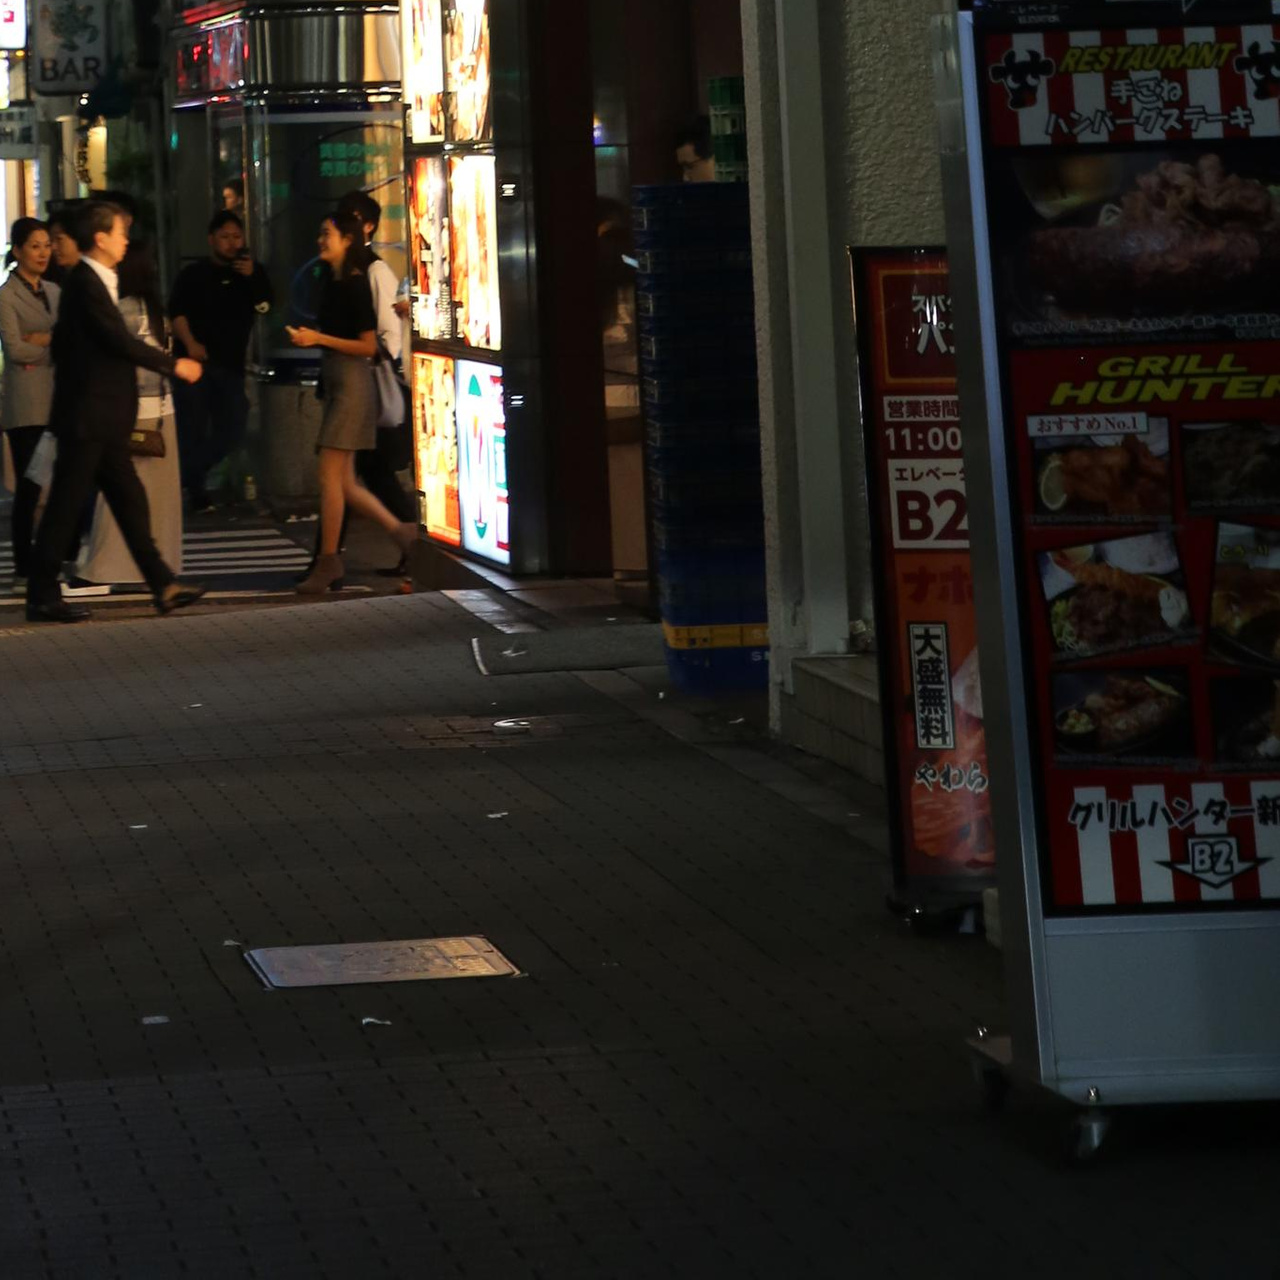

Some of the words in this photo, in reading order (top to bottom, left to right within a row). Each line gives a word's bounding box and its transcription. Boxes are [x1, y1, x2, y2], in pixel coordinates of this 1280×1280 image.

[39, 55, 101, 83] BAR
[1058, 42, 1238, 74] RESTAURANT
[1046, 105, 1255, 136] ハンバーグステーキ
[912, 294, 952, 313] スパ
[1096, 352, 1249, 379] GRILL
[1048, 373, 1280, 407] HUNTER
[887, 399, 960, 419] 営業時間
[1036, 416, 1100, 434] おすすめ
[1105, 414, 1139, 434] No.1
[885, 426, 962, 452] 11:00
[895, 489, 968, 540] B2
[914, 627, 950, 747] 大盛無料
[1192, 840, 1234, 875] B2
